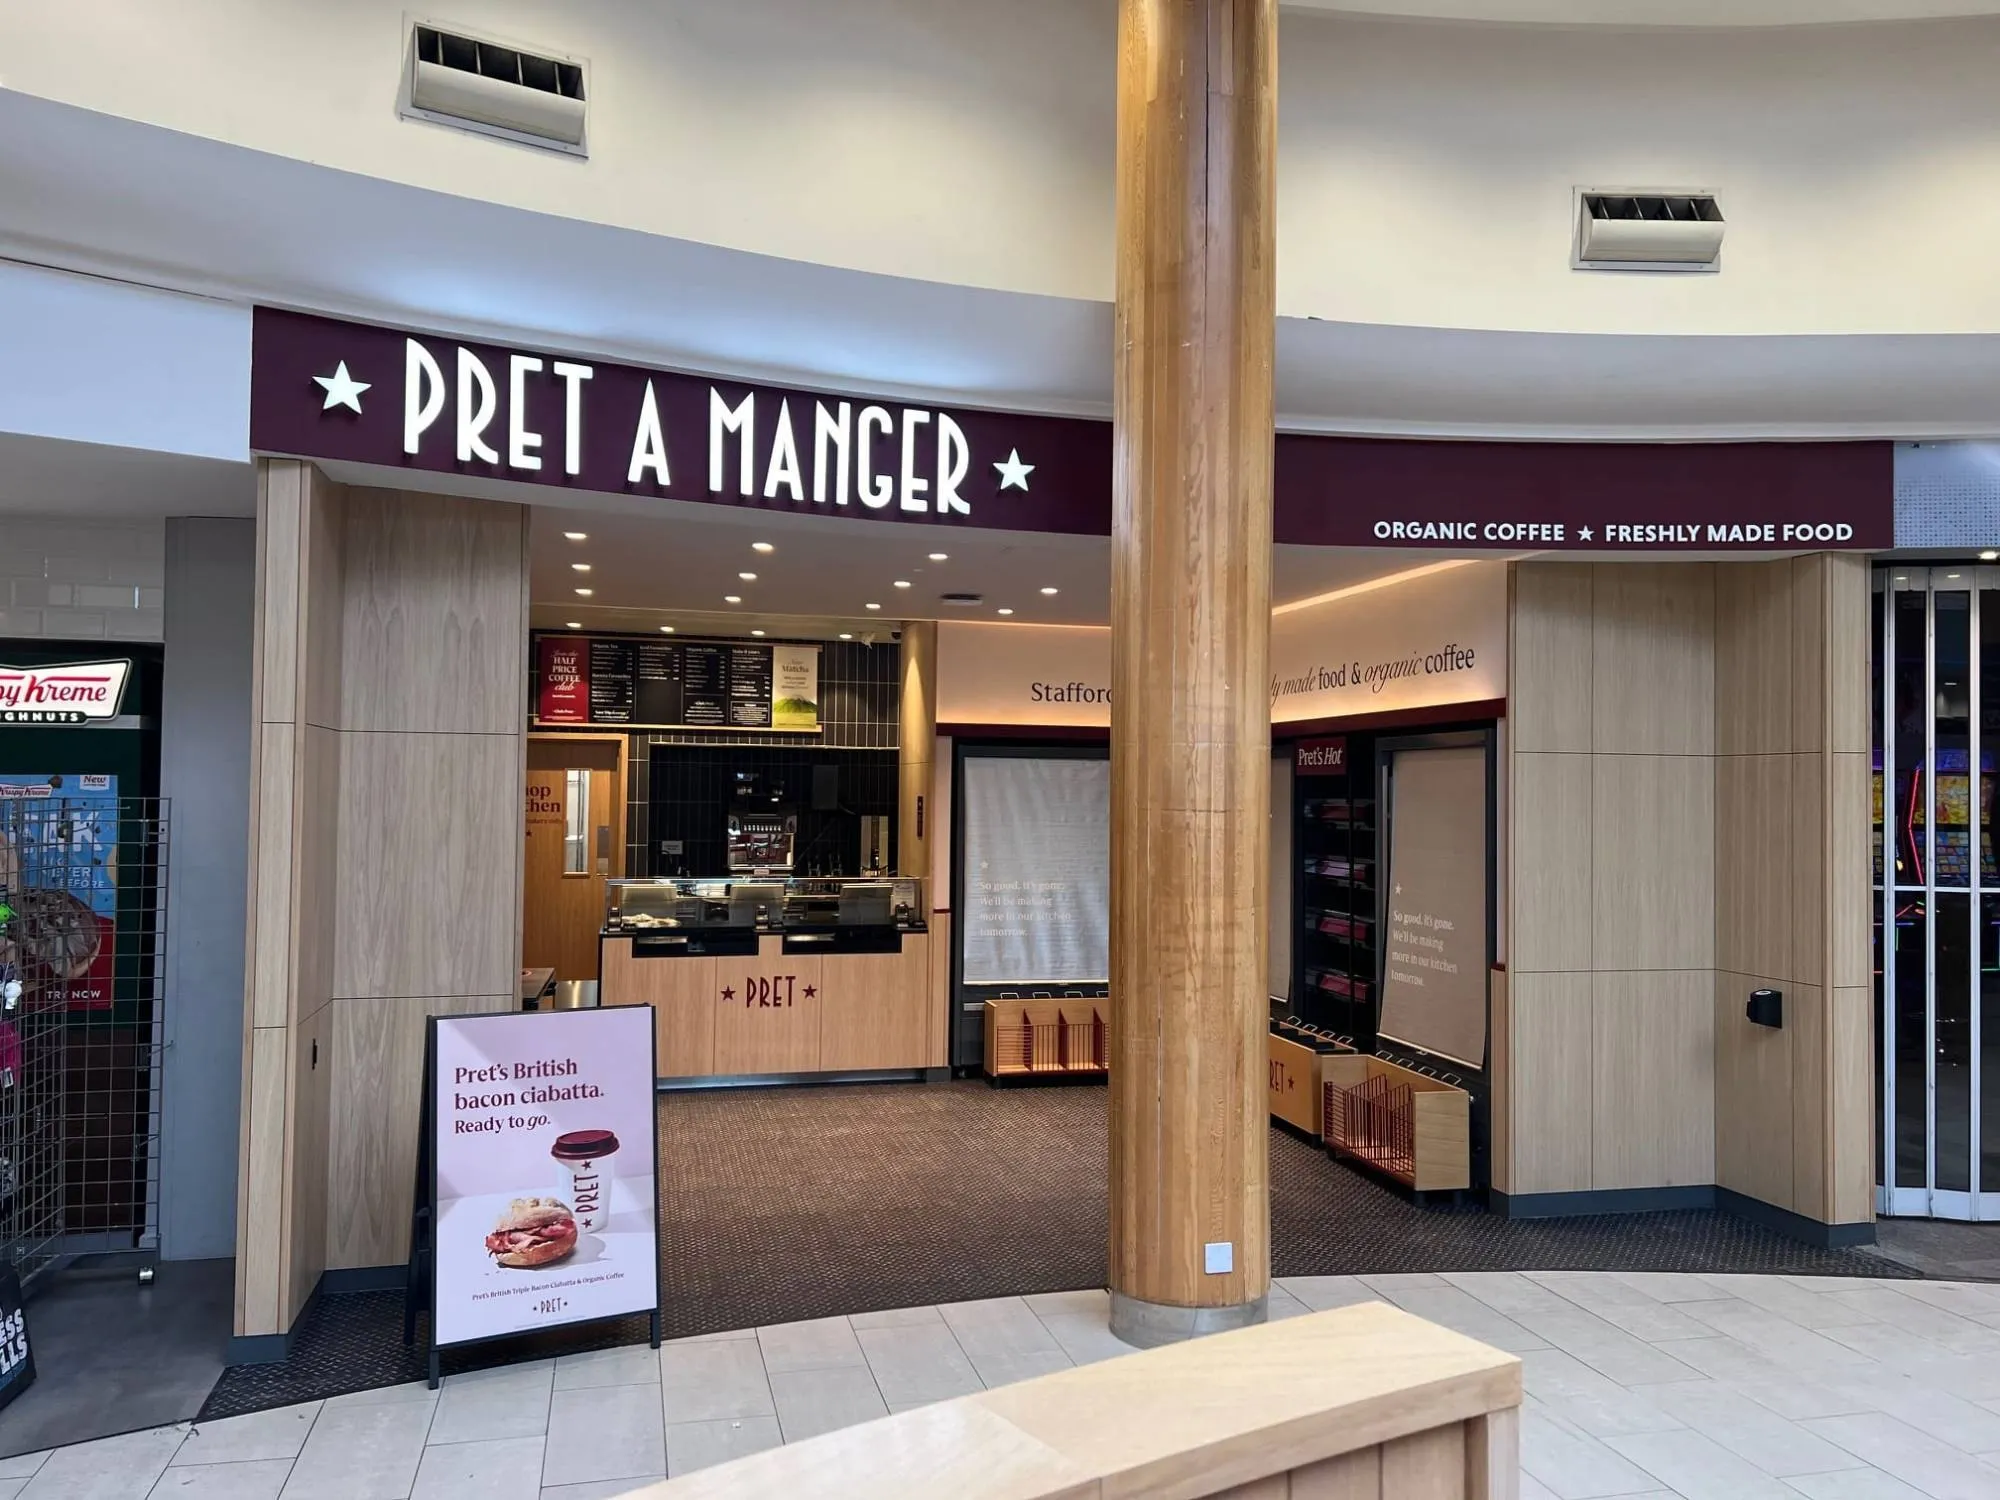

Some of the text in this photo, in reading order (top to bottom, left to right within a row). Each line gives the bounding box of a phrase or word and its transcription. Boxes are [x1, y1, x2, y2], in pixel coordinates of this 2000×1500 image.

[402, 337, 971, 516] PRET A MANGER
[1373, 521, 1565, 542] ORGANIC COFFEE
[1605, 523, 1853, 543] FRESHLY MADE FOOD
[553, 657, 577, 665] HALF
[1282, 667, 1316, 696] made
[1318, 664, 1346, 689] food
[1351, 662, 1361, 685] &
[1365, 651, 1423, 694] organic
[1425, 644, 1476, 674] coffee
[548, 674, 580, 682] COFFEE
[24, 675, 111, 703] Kreme
[1298, 745, 1343, 766] Pret's Hot
[526, 798, 561, 812] hen
[1393, 910, 1403, 922] So
[1410, 932, 1418, 945] be
[746, 975, 796, 1008] PRET
[455, 1058, 578, 1084] Pret's British
[455, 1083, 605, 1110] bacon ciabatta.
[455, 1115, 551, 1134] Ready to go.
[574, 1174, 599, 1213] PRET
[540, 1297, 561, 1314] PRET
